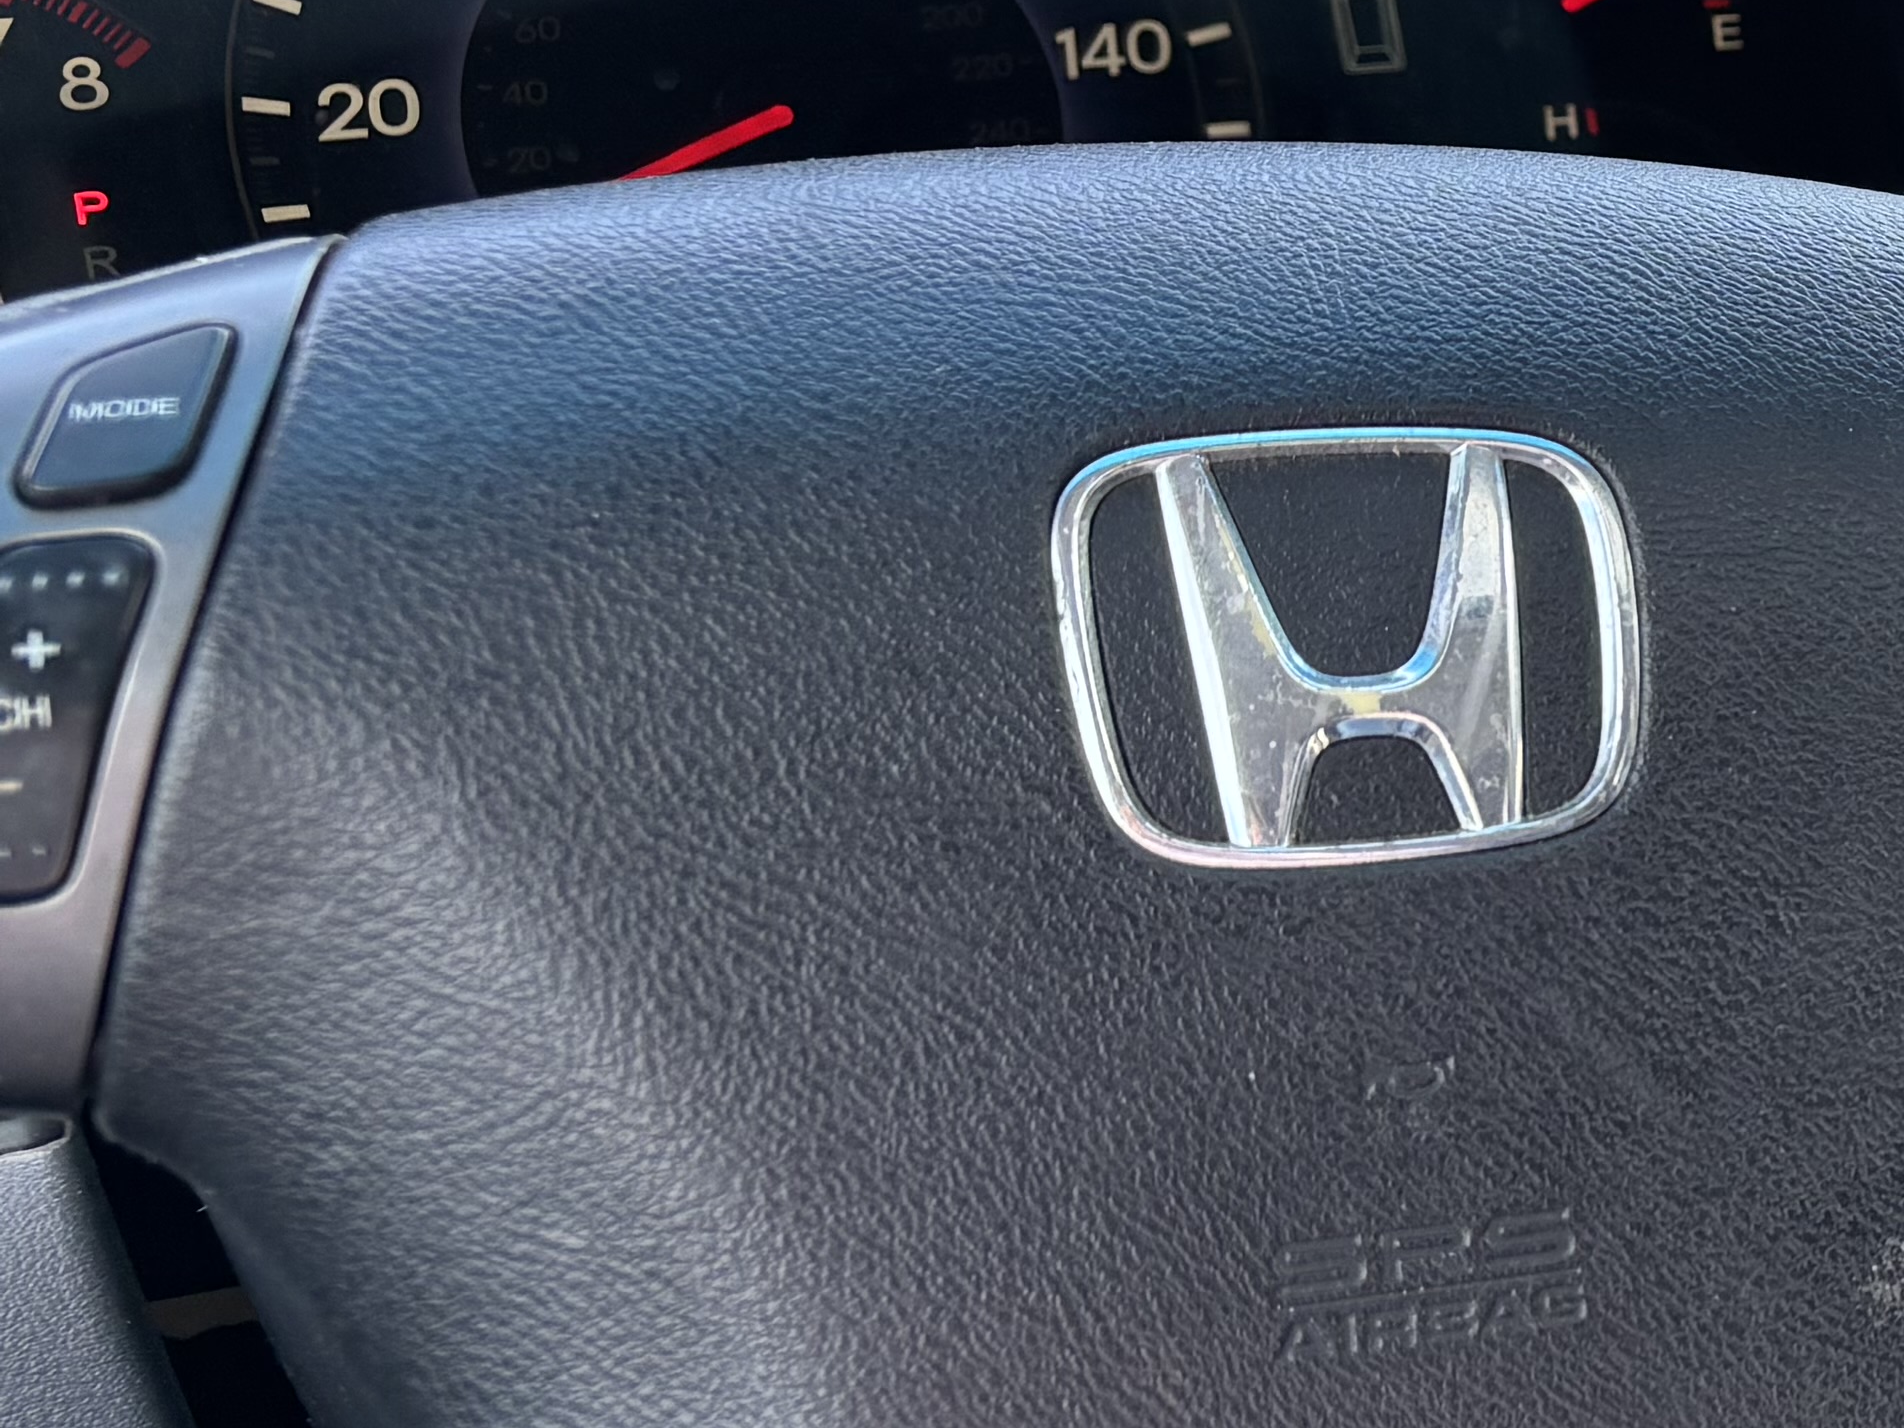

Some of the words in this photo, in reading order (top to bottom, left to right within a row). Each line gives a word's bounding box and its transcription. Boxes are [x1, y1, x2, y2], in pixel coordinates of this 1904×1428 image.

[1055, 18, 1173, 81] 140
[1710, 13, 1744, 53] E
[59, 55, 110, 111] 8
[316, 77, 421, 143] 20
[1543, 104, 1580, 141] H
[72, 190, 109, 225] P
[83, 244, 120, 281] R
[67, 395, 182, 423] MODE
